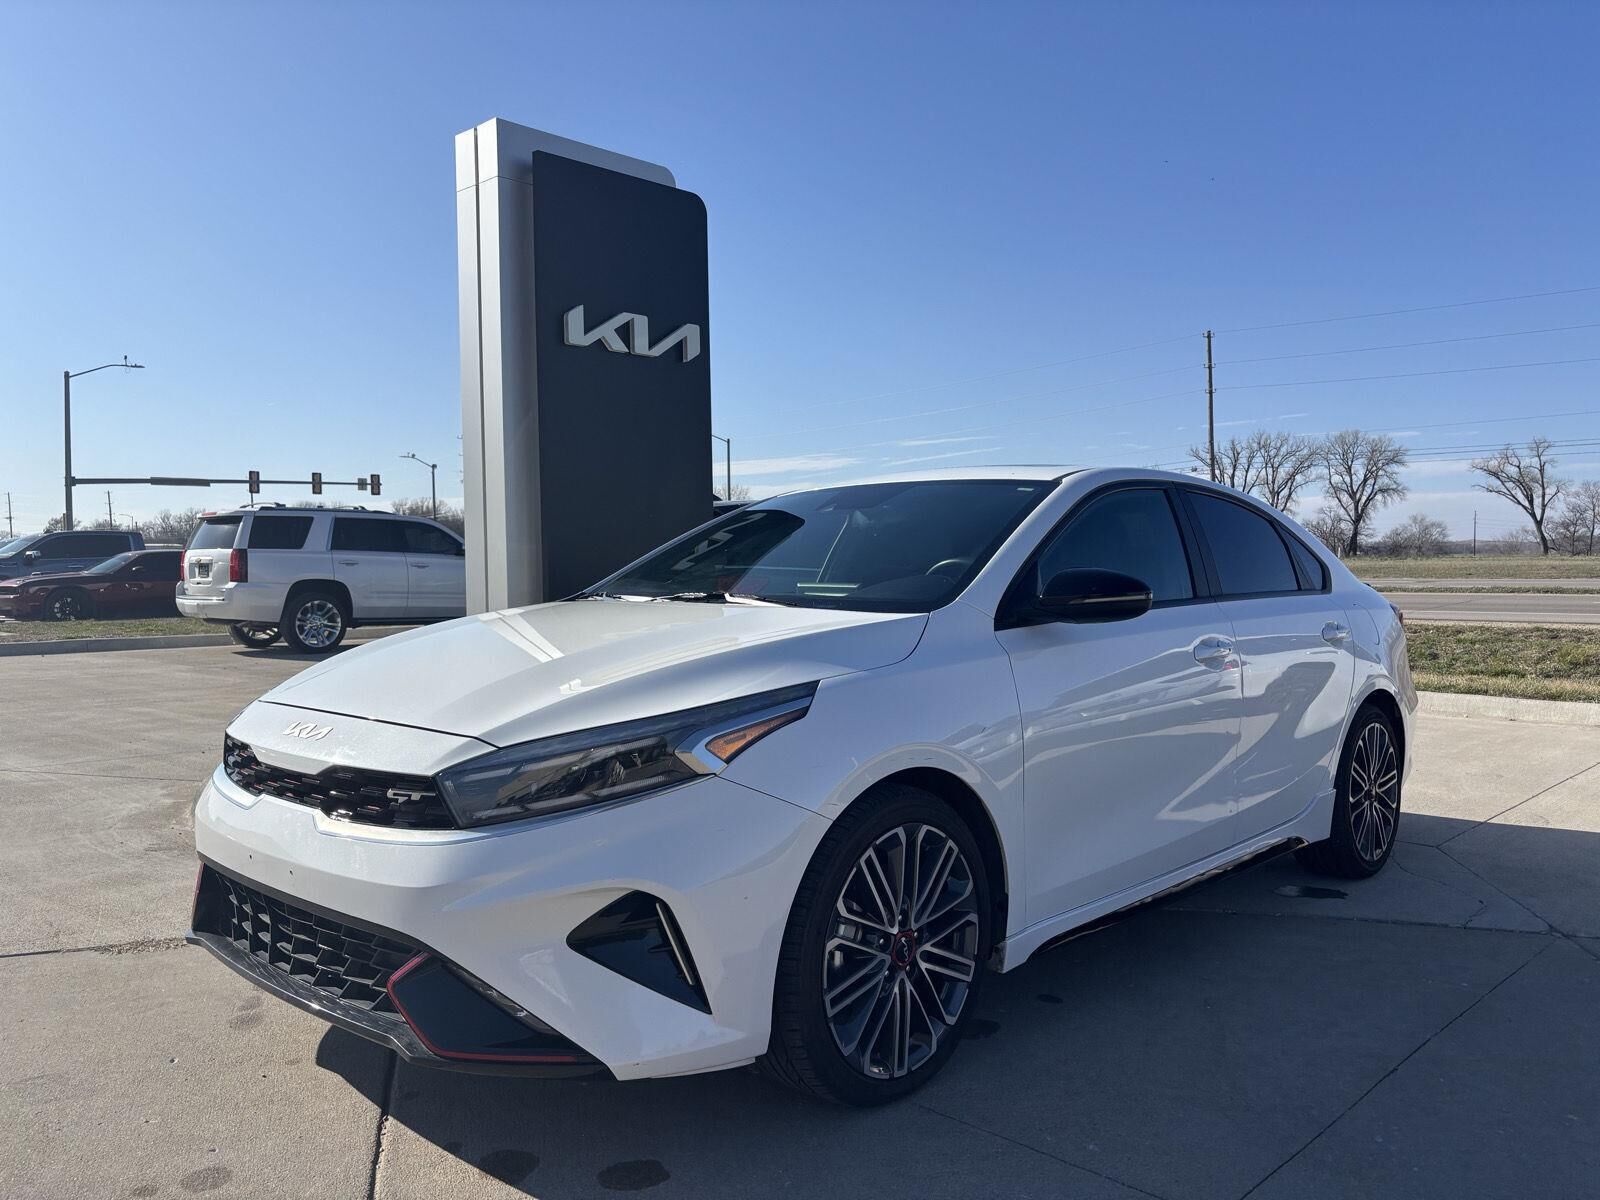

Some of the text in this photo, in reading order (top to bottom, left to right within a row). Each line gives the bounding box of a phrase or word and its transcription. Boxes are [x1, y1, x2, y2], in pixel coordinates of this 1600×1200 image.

[564, 304, 701, 363] KIA
[282, 721, 334, 741] KIA
[386, 788, 436, 806] GT
